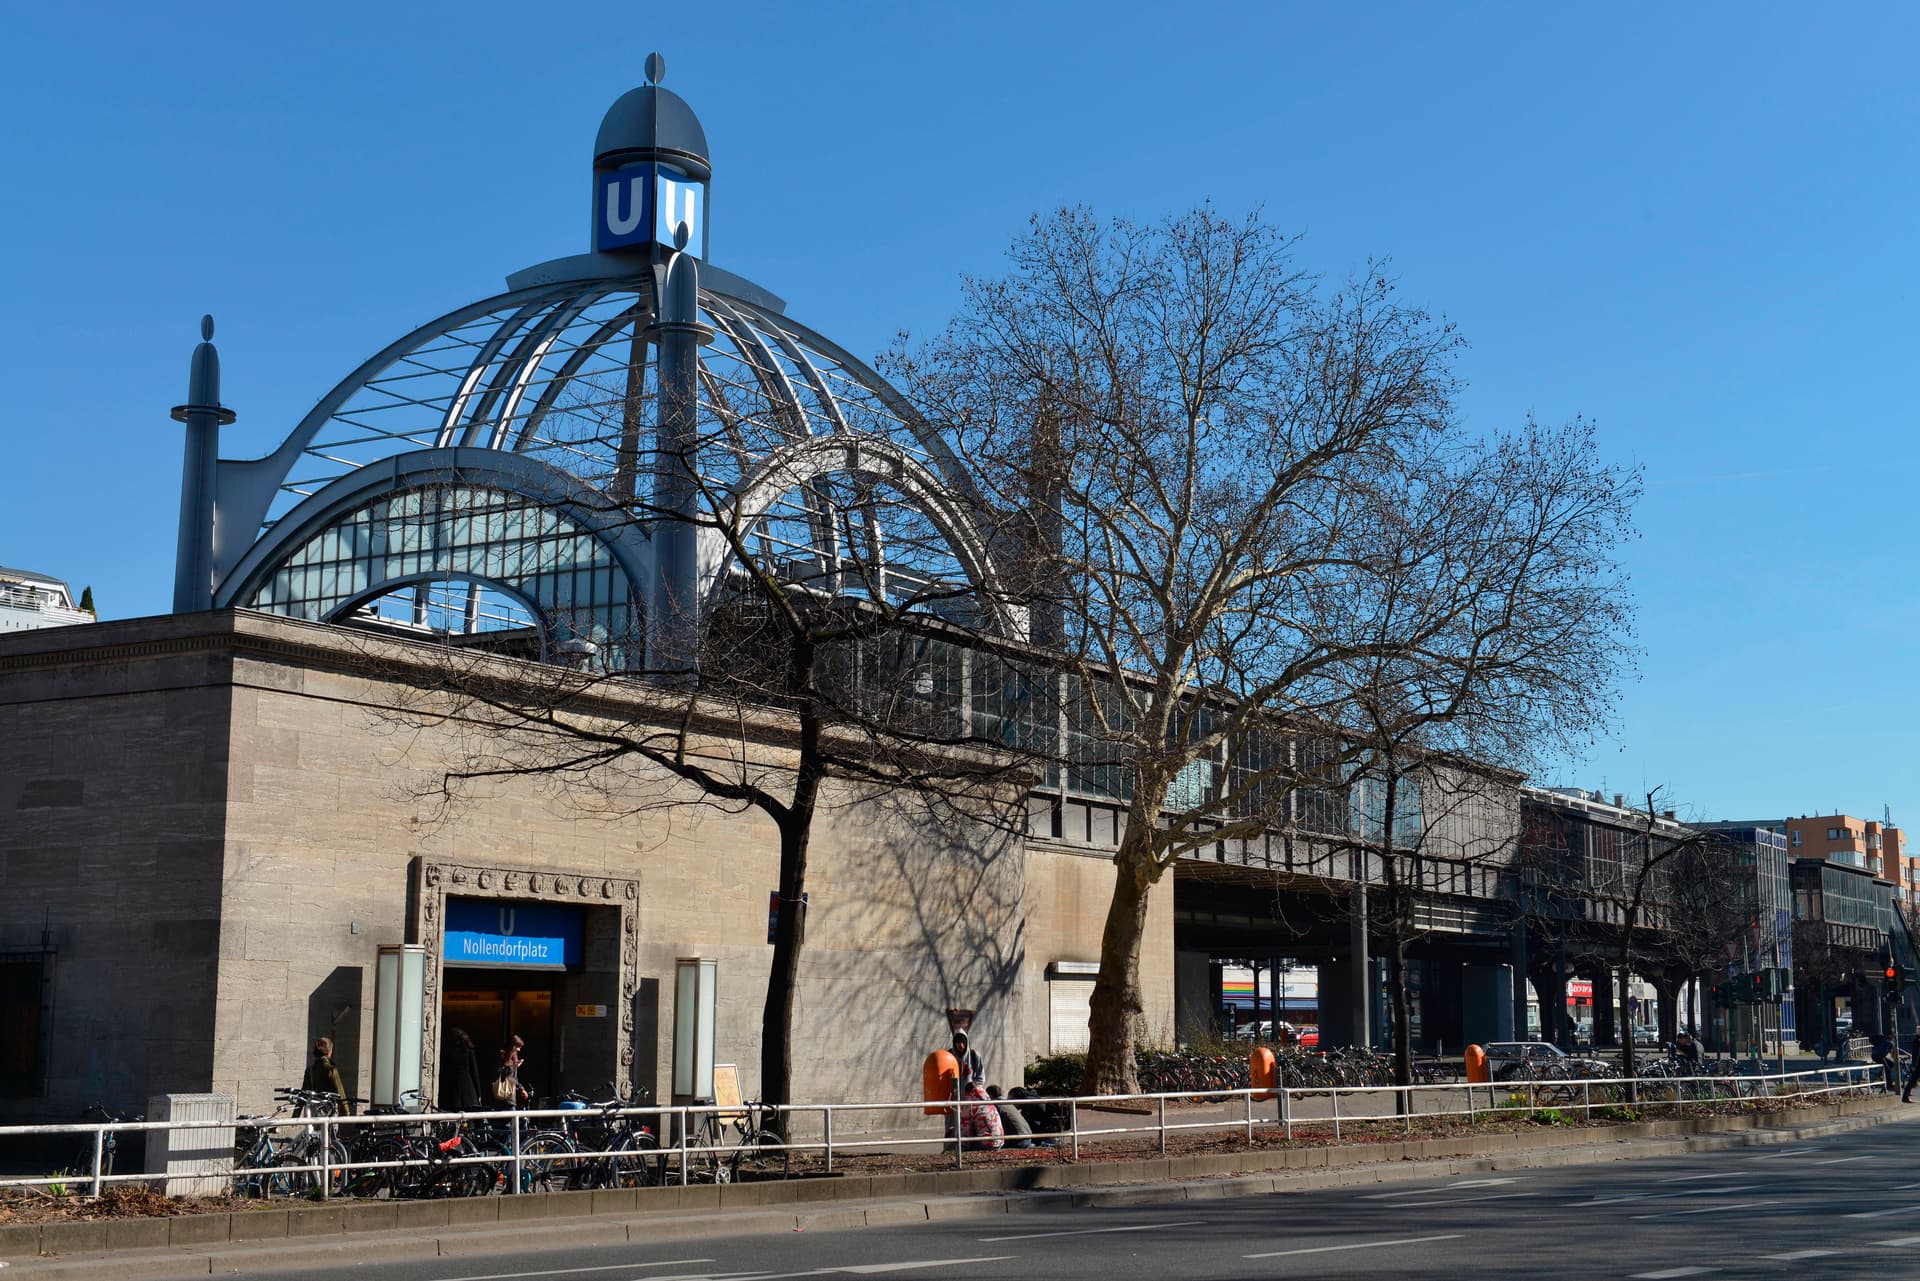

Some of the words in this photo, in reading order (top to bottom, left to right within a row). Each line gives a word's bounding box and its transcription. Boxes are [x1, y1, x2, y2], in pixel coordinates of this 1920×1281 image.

[606, 175, 644, 236] U
[665, 179, 695, 240] U
[499, 907, 515, 936] U
[463, 937, 548, 961] Nollendorfplatz
